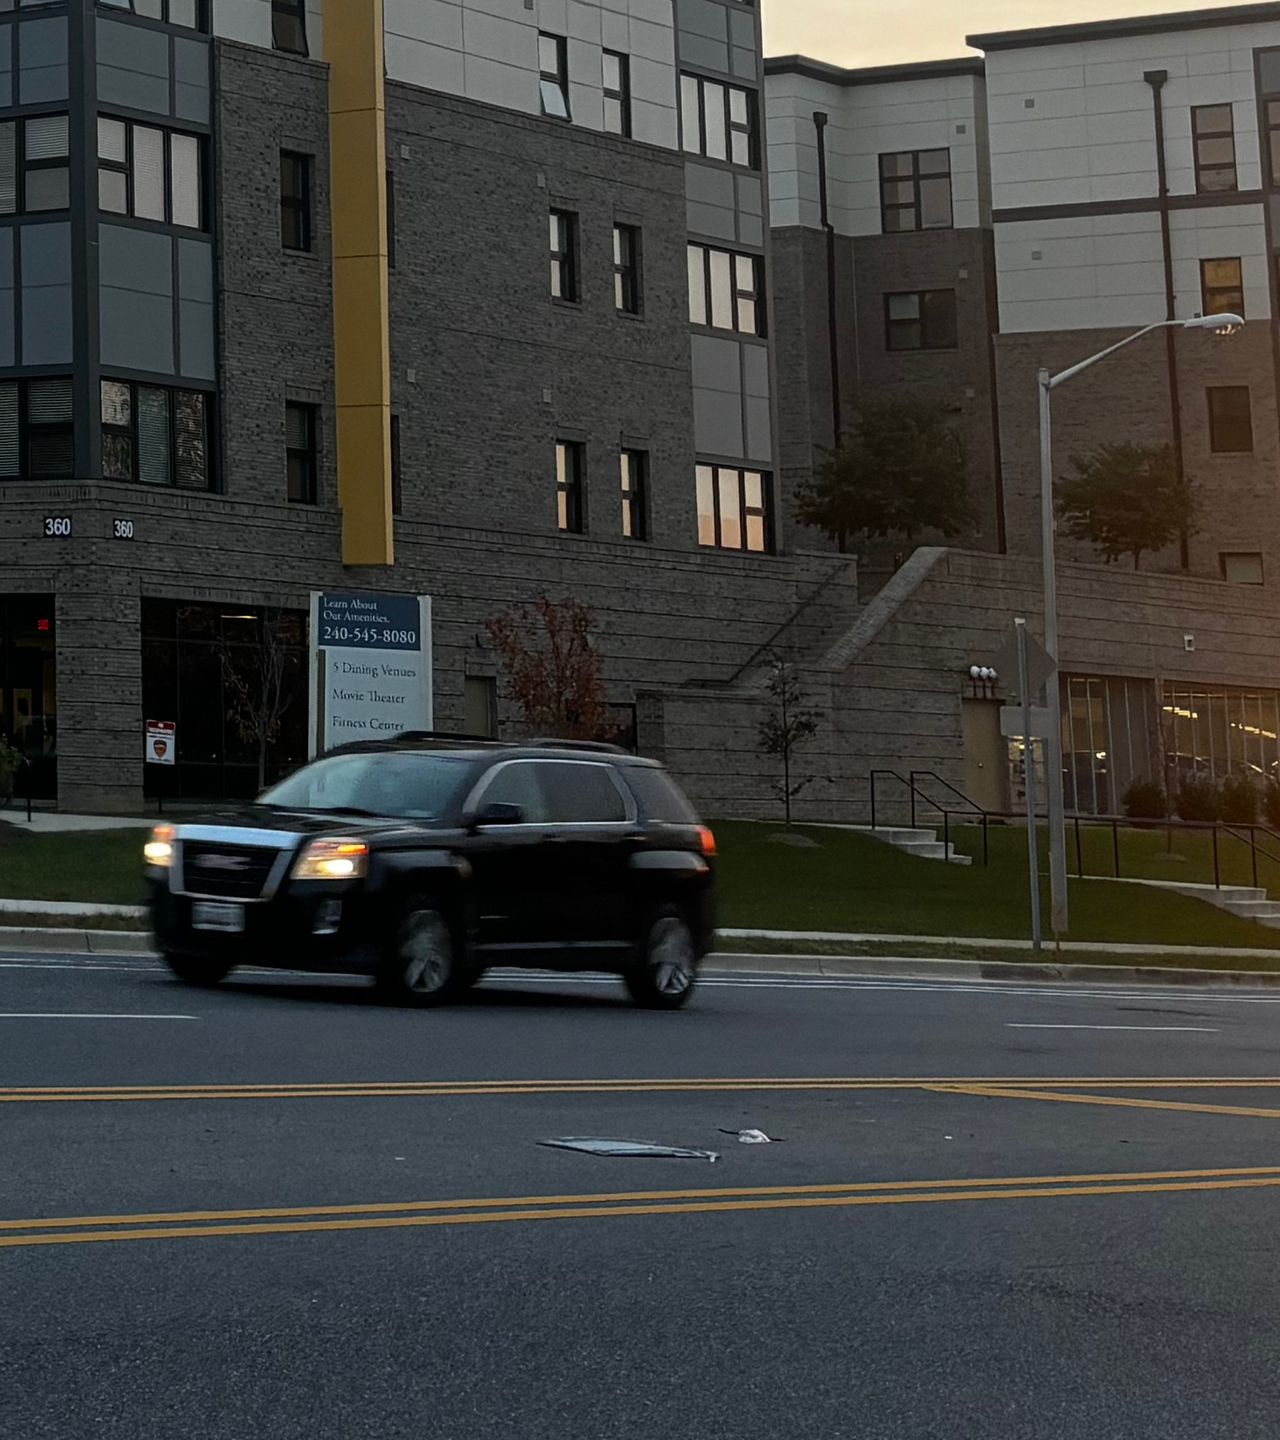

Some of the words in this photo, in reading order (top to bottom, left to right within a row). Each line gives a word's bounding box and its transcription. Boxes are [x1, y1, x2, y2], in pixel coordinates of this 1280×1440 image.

[45, 518, 71, 535] 360
[114, 520, 134, 538] 360
[323, 597, 347, 608] Learn
[350, 598, 377, 610] About
[323, 626, 416, 644] 240-545-8080
[333, 662, 339, 672] 5
[342, 662, 378, 678] Dining
[381, 664, 416, 677] Venues
[332, 688, 364, 701] Movie
[367, 690, 405, 704] Theater
[332, 715, 366, 728] Fitness
[369, 718, 405, 731] Center
